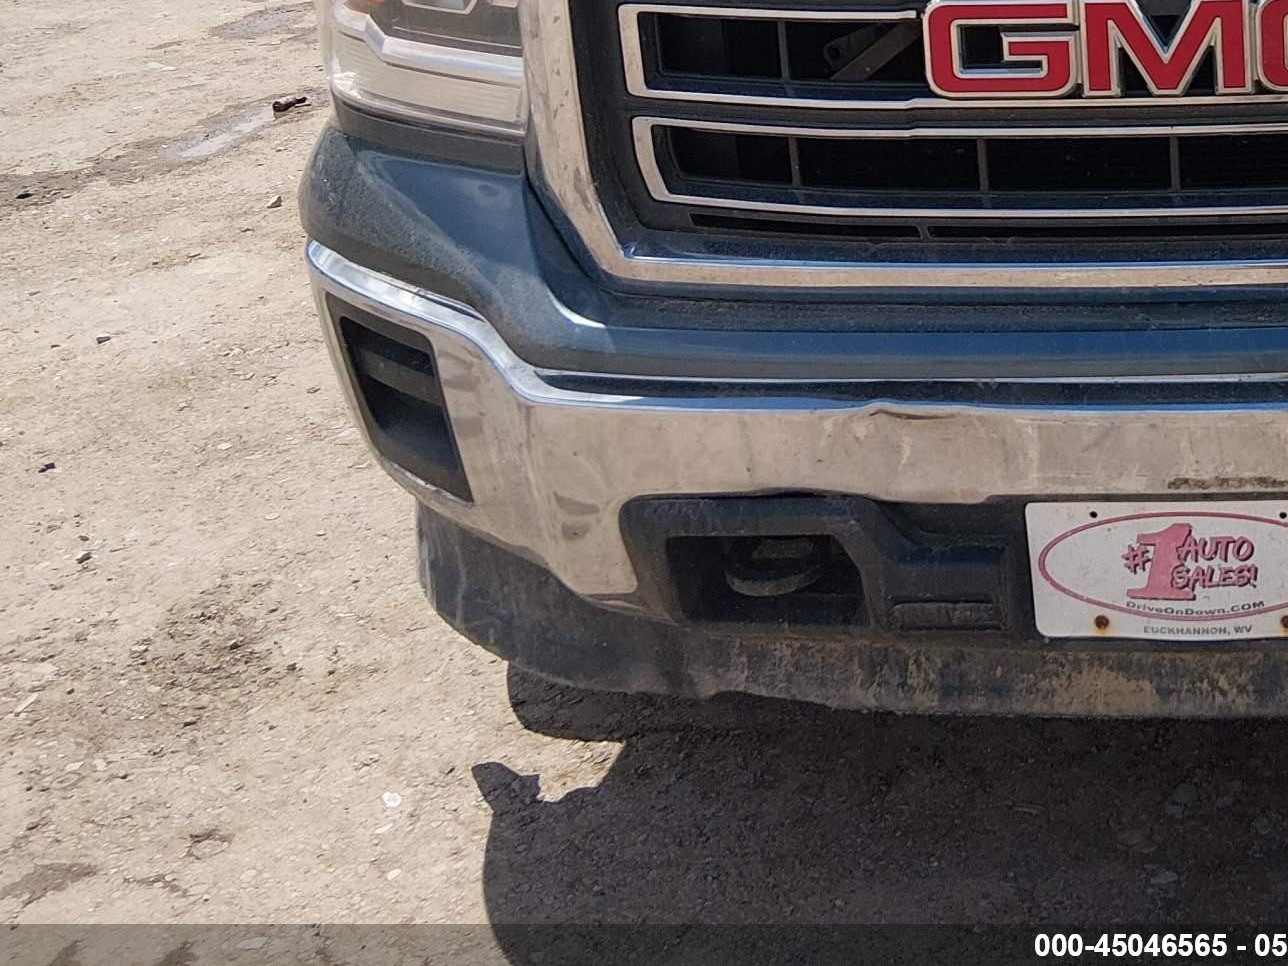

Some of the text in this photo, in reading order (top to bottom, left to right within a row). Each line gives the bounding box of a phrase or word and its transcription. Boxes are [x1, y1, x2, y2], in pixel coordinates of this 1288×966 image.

[1176, 536, 1255, 563] AUTO
[1171, 563, 1259, 592] SALES!
[1233, 625, 1253, 634] WV
